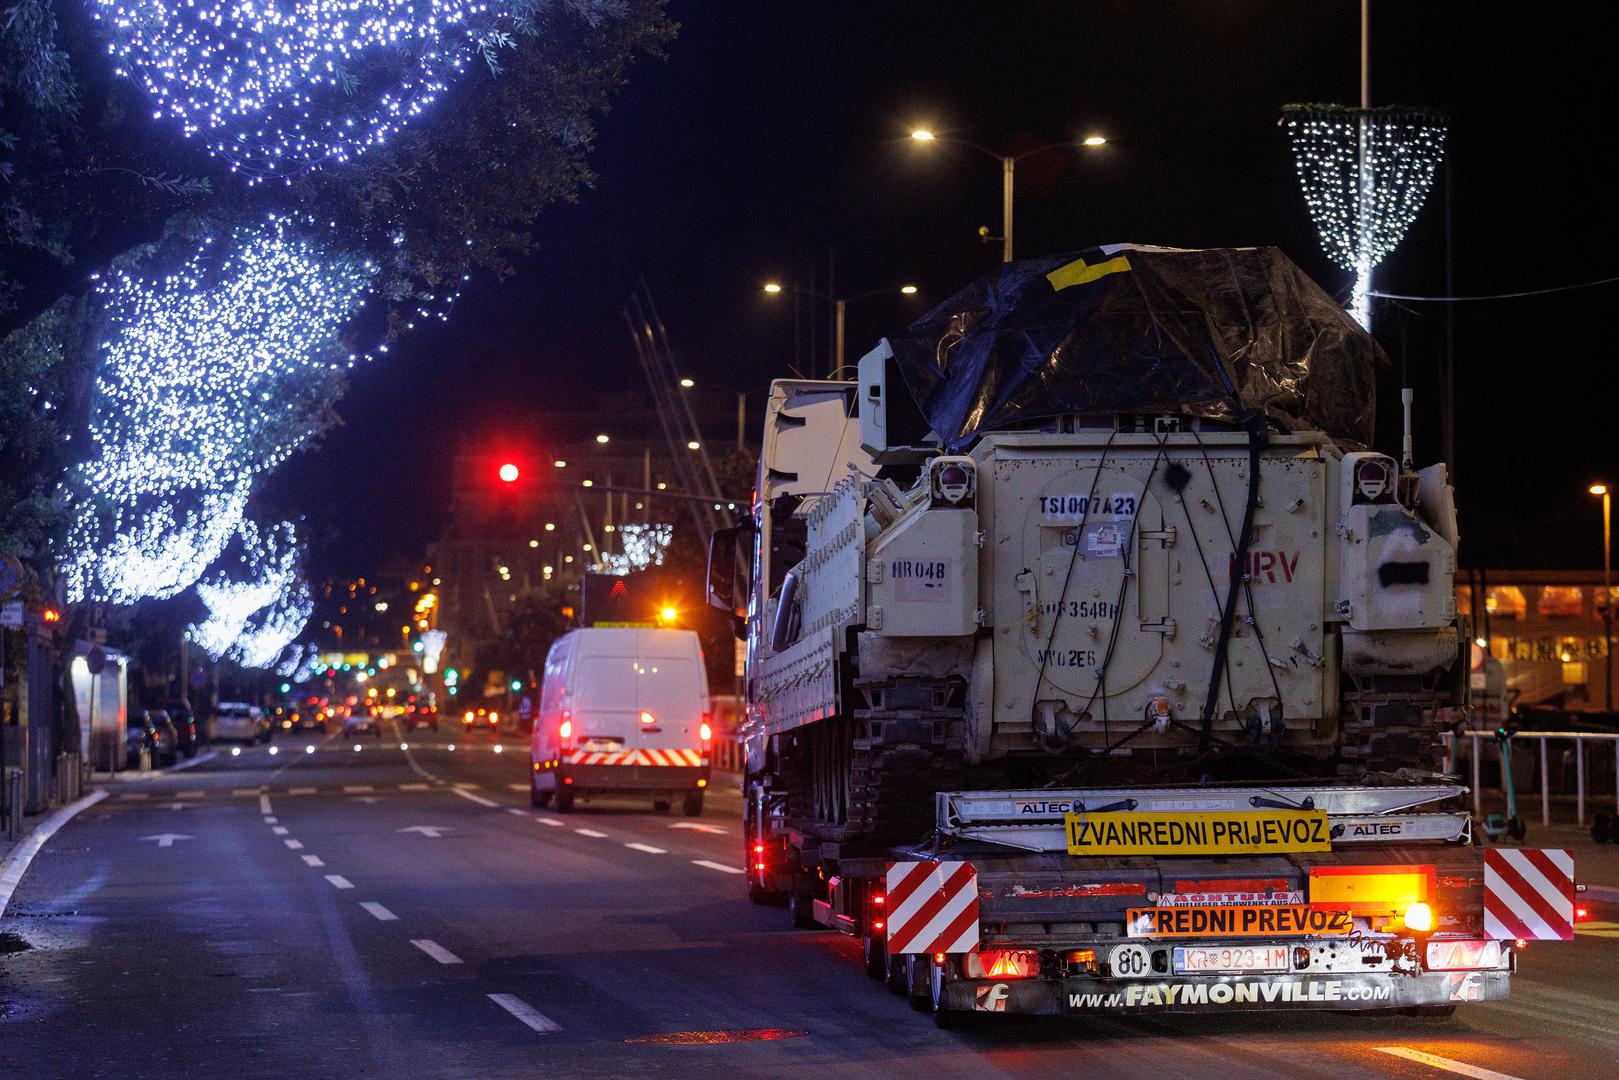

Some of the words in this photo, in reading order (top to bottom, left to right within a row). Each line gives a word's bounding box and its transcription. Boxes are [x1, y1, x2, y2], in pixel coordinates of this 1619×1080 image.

[1021, 801, 1070, 814] ALTEC
[1070, 821, 1208, 847] IZVANREDNI
[1212, 818, 1326, 845] PRIJEVOZ
[1353, 823, 1401, 836] ALTEC
[1131, 909, 1235, 935] IZREDNI
[1242, 907, 1346, 932] PREVOZ
[1118, 950, 1143, 975] 80
